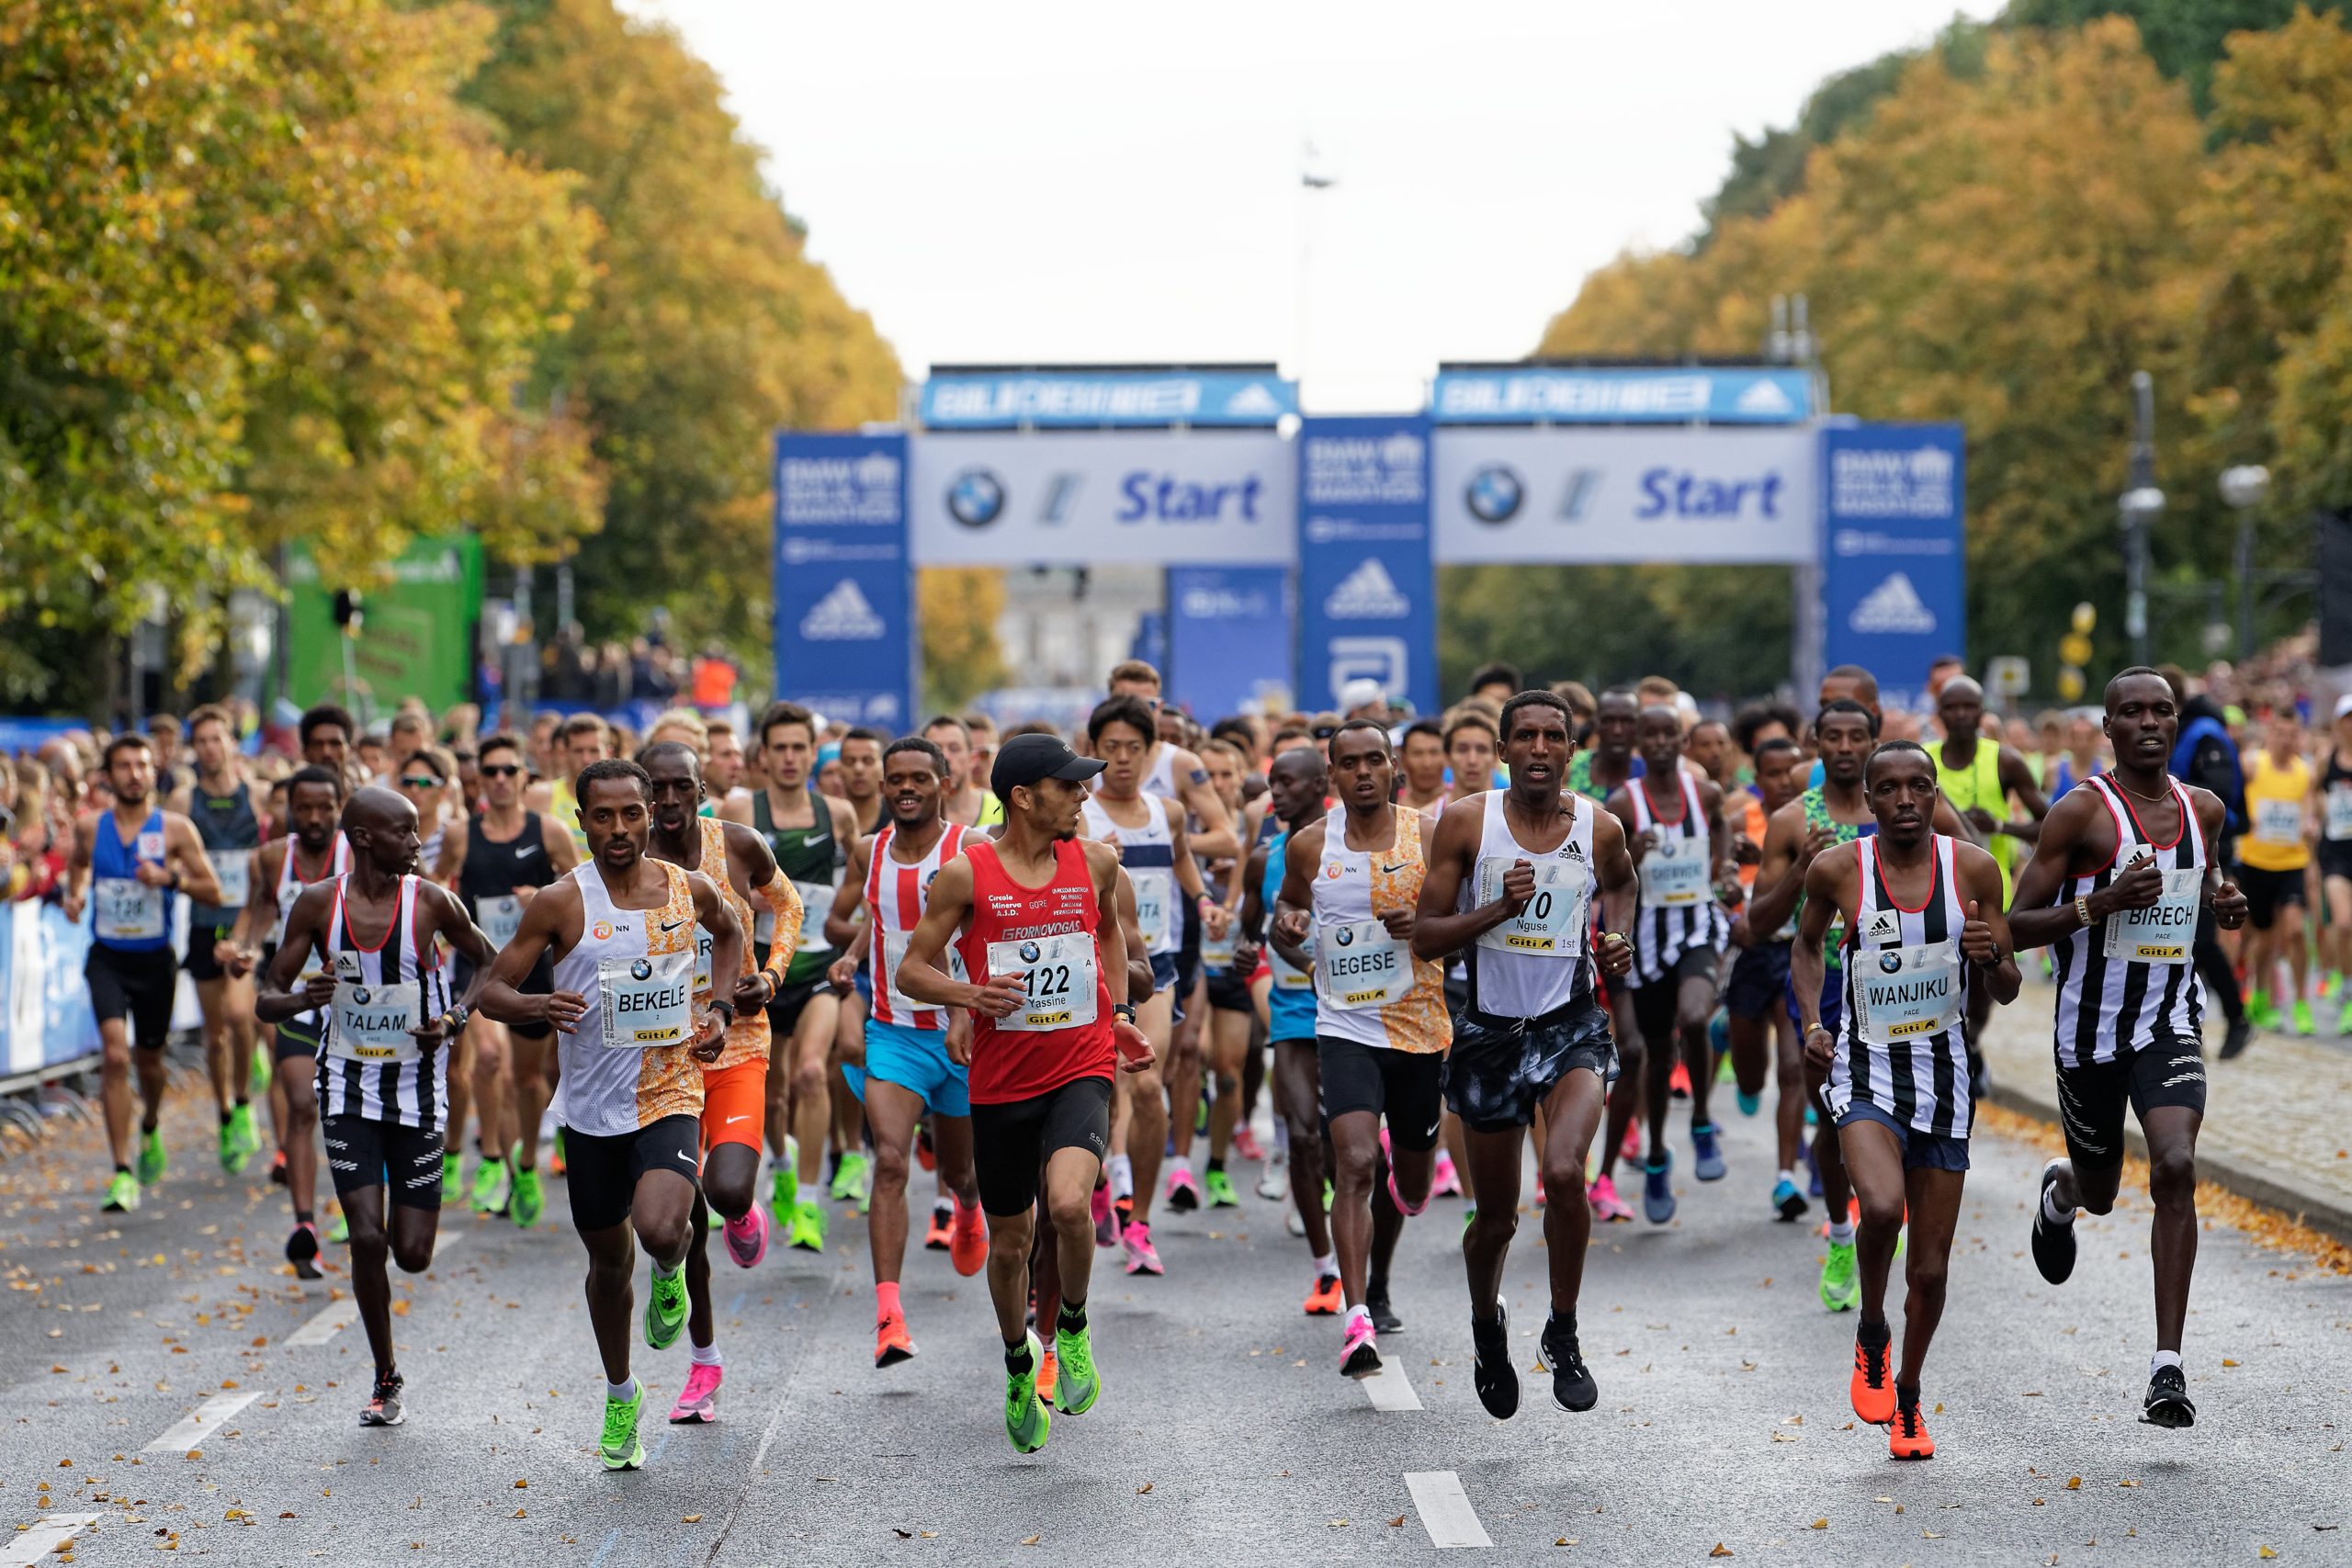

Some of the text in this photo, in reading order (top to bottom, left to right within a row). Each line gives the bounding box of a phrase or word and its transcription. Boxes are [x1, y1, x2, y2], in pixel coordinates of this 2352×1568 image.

[1117, 469, 1261, 524] Start
[1634, 467, 1783, 522] Start
[1558, 852, 1586, 863] adidas
[1029, 900, 1047, 908] GORE
[2129, 906, 2194, 925] BIRECH
[616, 923, 629, 931] NN
[1014, 920, 1080, 939] FORNOVOGAS
[1516, 919, 1548, 932] Nguse
[1869, 928, 1895, 937] adidas
[1510, 938, 1536, 947] Giti
[1562, 939, 1576, 948] 1st
[1085, 959, 1091, 967] A
[1332, 952, 1395, 976] LEGESE
[1023, 964, 1069, 997] 122
[1870, 976, 1948, 1006] WANJIKU
[618, 985, 684, 1012] BEKELE
[1029, 996, 1066, 1009] Yassine
[1347, 993, 1370, 1002] Giti
[345, 1011, 406, 1031] TALAM
[1029, 1015, 1055, 1023] Giti
[1893, 1024, 1919, 1034] Giti
[637, 1032, 664, 1040] Giti
